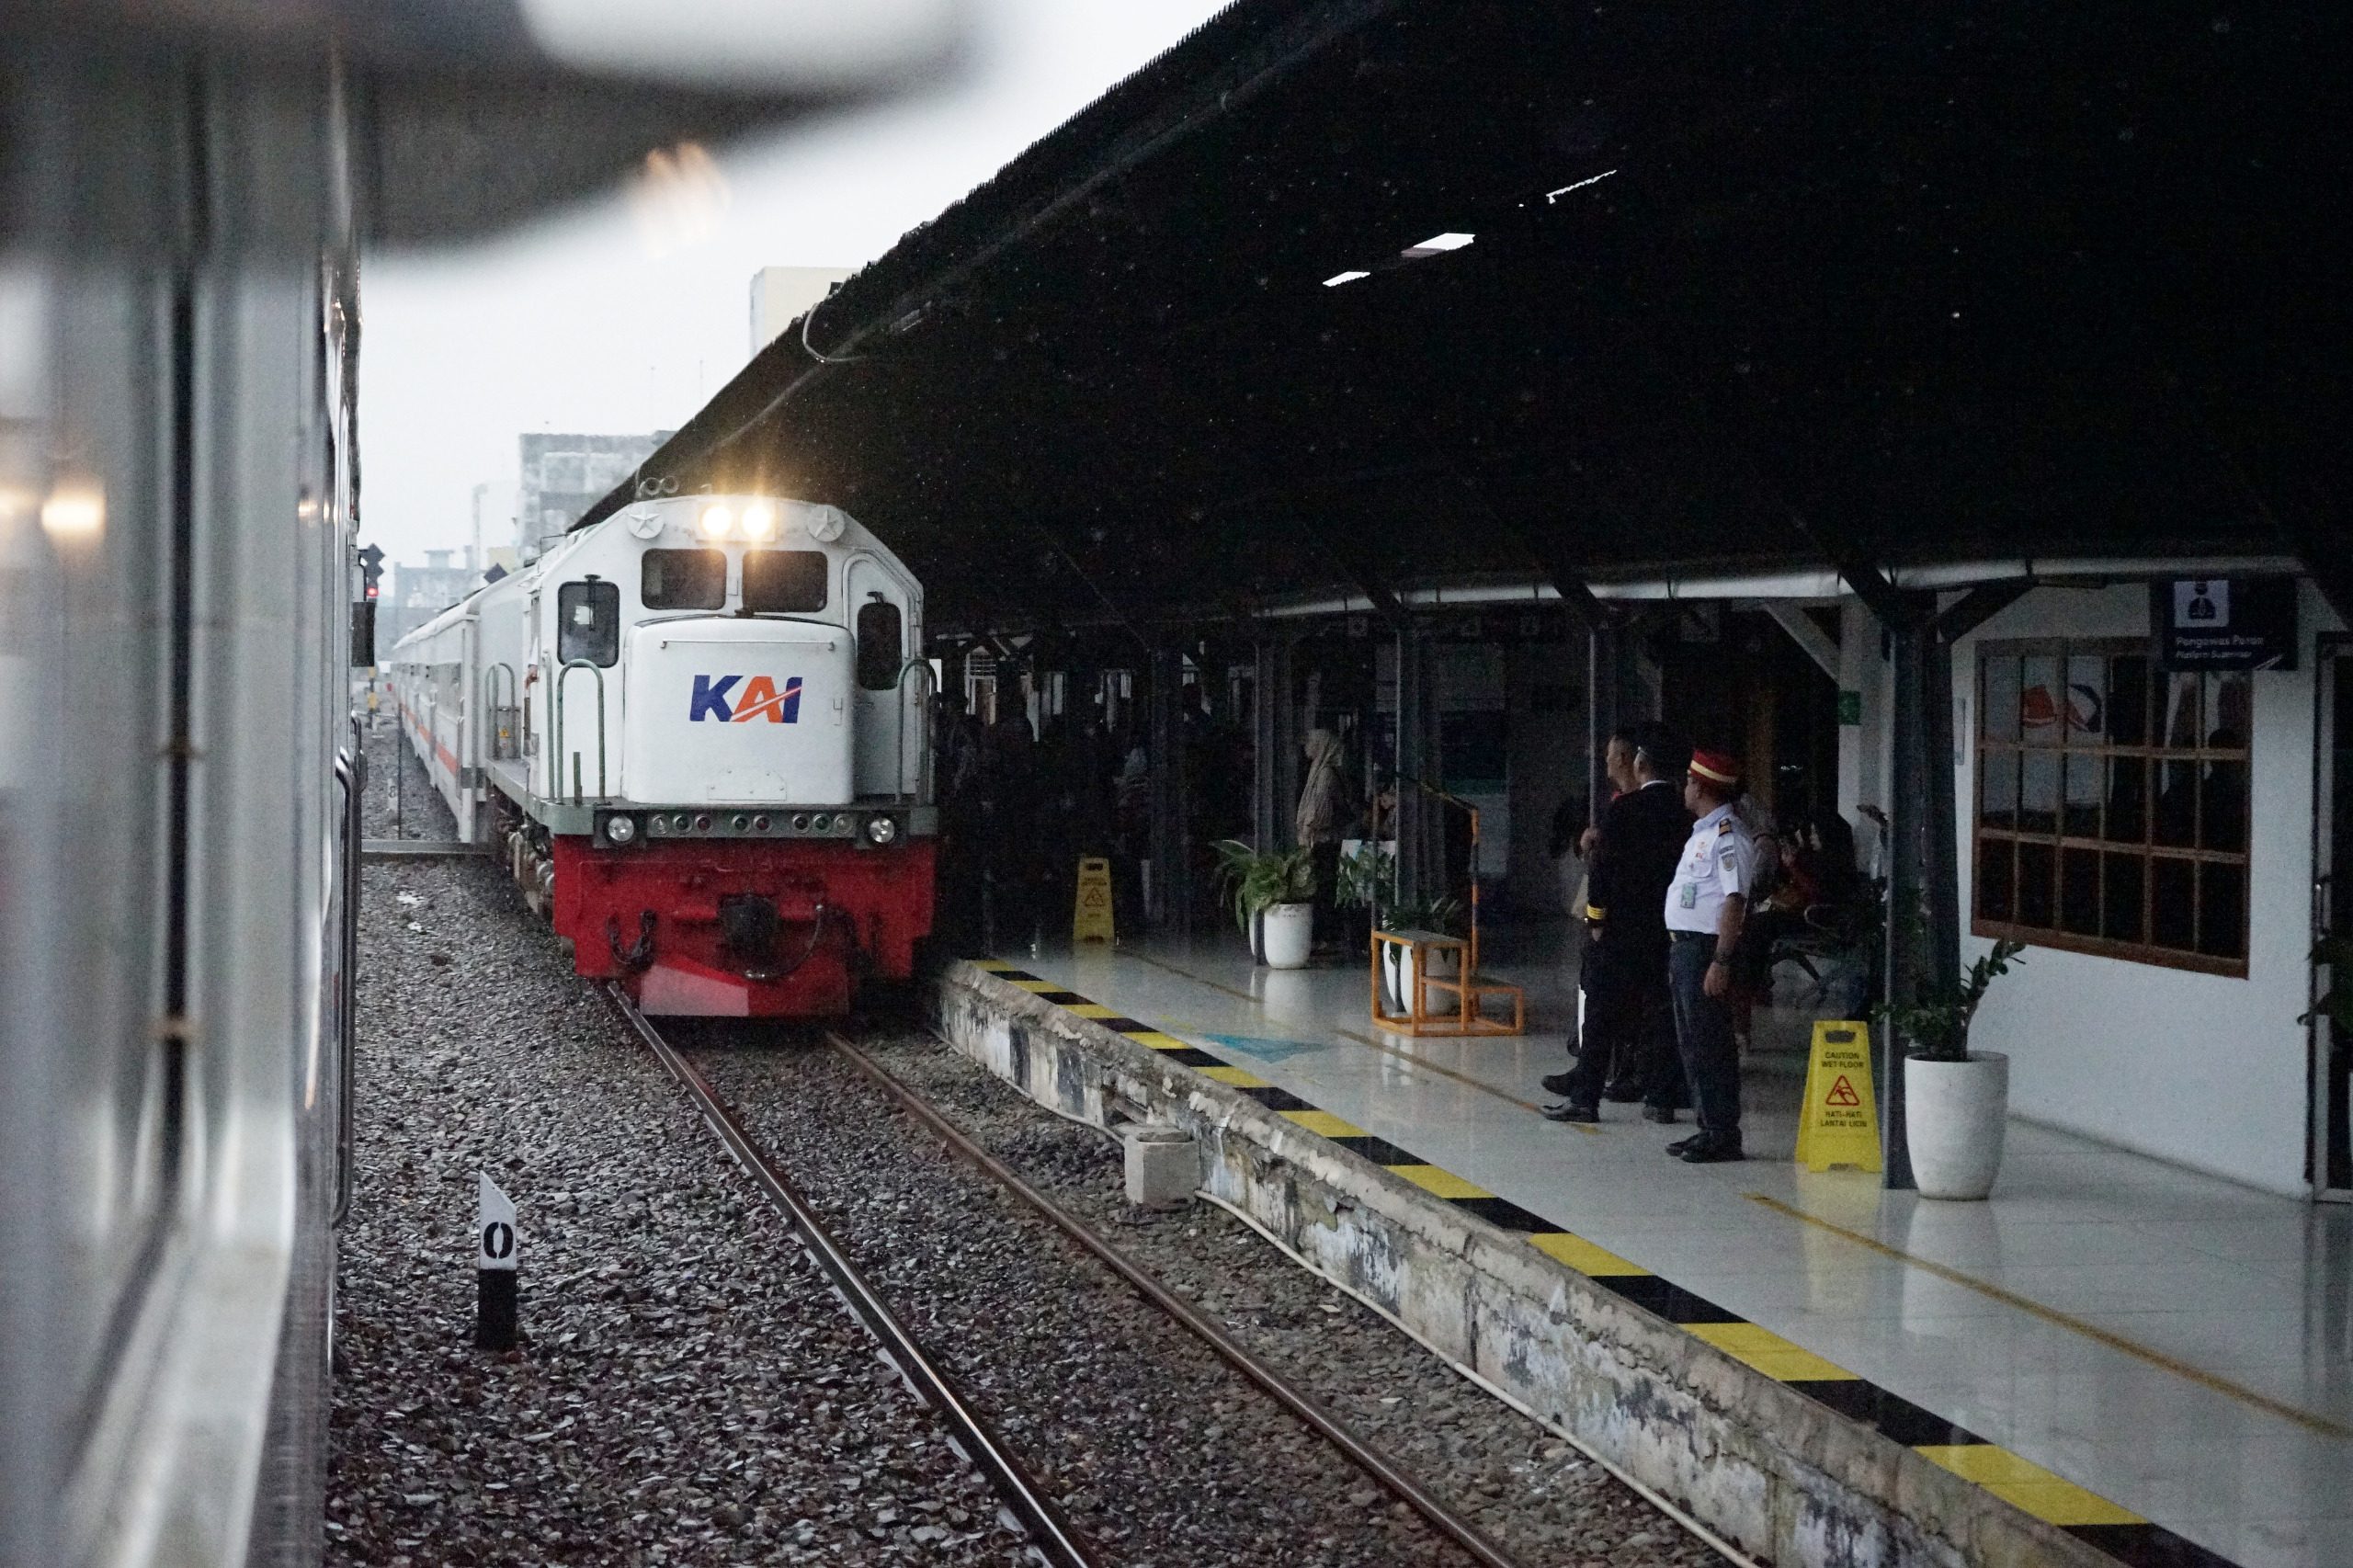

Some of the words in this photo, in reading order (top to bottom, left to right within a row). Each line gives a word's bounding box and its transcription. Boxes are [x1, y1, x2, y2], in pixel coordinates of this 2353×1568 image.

[689, 675, 803, 724] KAI
[1848, 1119, 1868, 1128] LICIN
[483, 1221, 514, 1259] 0
